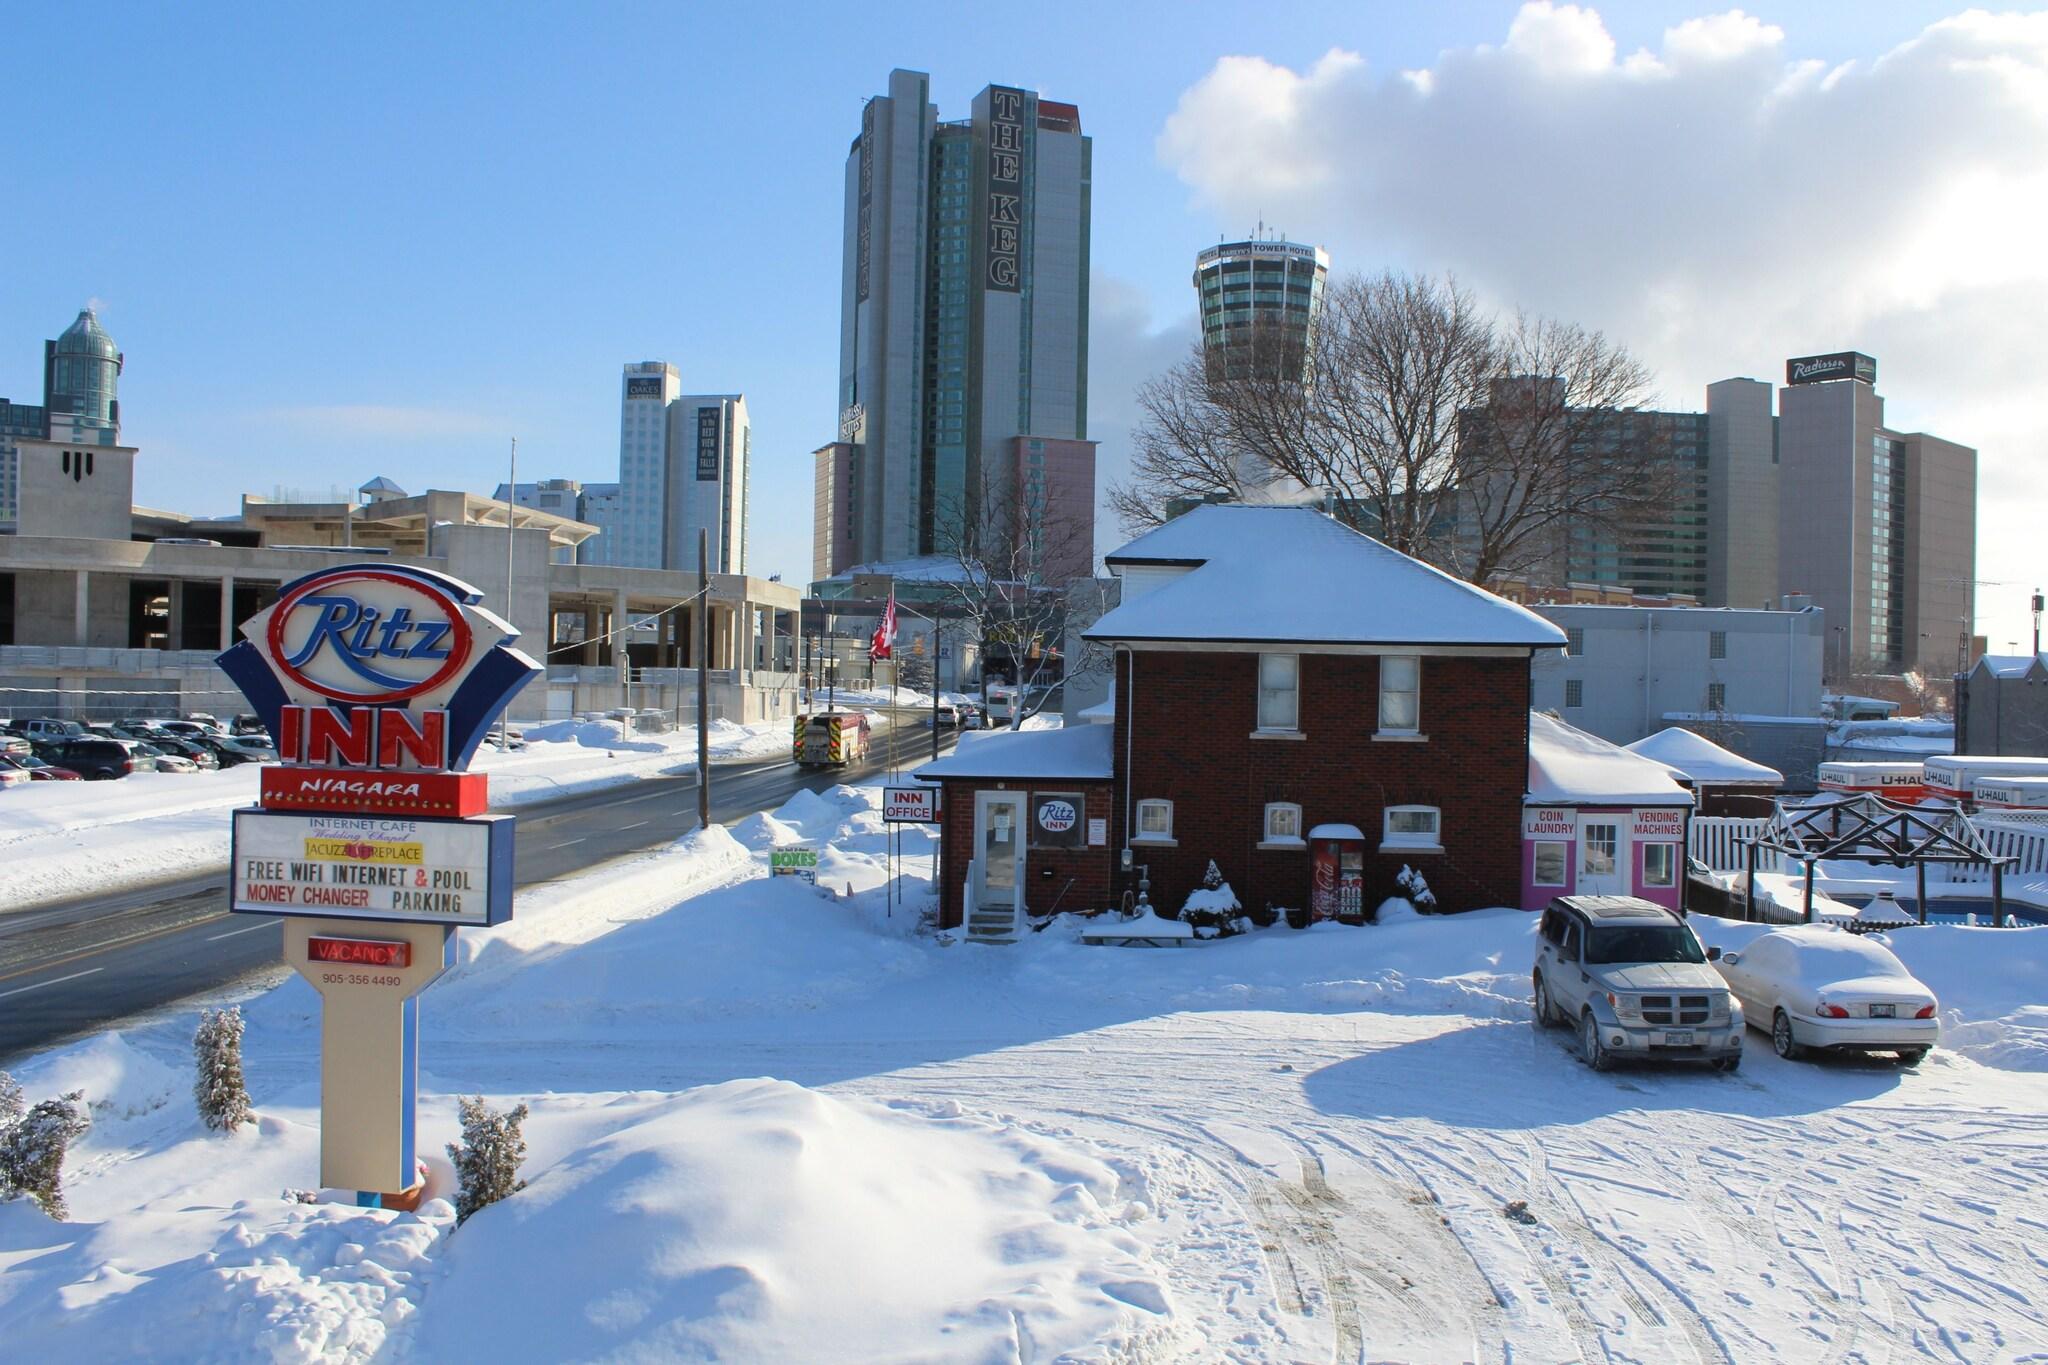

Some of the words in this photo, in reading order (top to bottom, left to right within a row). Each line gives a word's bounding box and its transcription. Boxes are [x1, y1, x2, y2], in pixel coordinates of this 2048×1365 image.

[991, 90, 1022, 183] THE
[989, 193, 1020, 287] KEG
[1253, 244, 1287, 253] TOWER
[1289, 246, 1313, 257] HOTEL
[1794, 359, 1846, 379] Radisson
[630, 385, 659, 394] OAKES
[286, 595, 452, 690] Ritz
[281, 705, 446, 768] INN
[1821, 772, 1846, 784] U-HAUL
[1924, 770, 1953, 786] U-HAUL
[300, 778, 420, 797] NIAGARA
[894, 792, 923, 804] INN
[1977, 789, 2009, 802] U-HAUL
[886, 806, 930, 818] OFFICE
[1041, 804, 1074, 820] Ritz
[1539, 810, 1564, 822] COIN
[1638, 811, 1679, 823] VENDING
[309, 818, 375, 830] INTERNET
[380, 822, 417, 832] CAFE
[1046, 821, 1068, 829] INN
[1527, 823, 1575, 834] LAUNDRY
[1634, 824, 1682, 835] MACHINES
[312, 829, 362, 841] Wedding
[366, 831, 410, 843] Chapel
[771, 852, 817, 867] BOXES
[248, 860, 283, 881] FREE
[291, 862, 323, 882] WIFI
[333, 865, 407, 886] INTERNET
[414, 868, 428, 887] &
[433, 870, 472, 890] POOL
[247, 884, 295, 903] MONEY
[303, 886, 369, 907] CHANGER
[392, 891, 462, 913] PARKING
[318, 943, 399, 964] VACANCY
